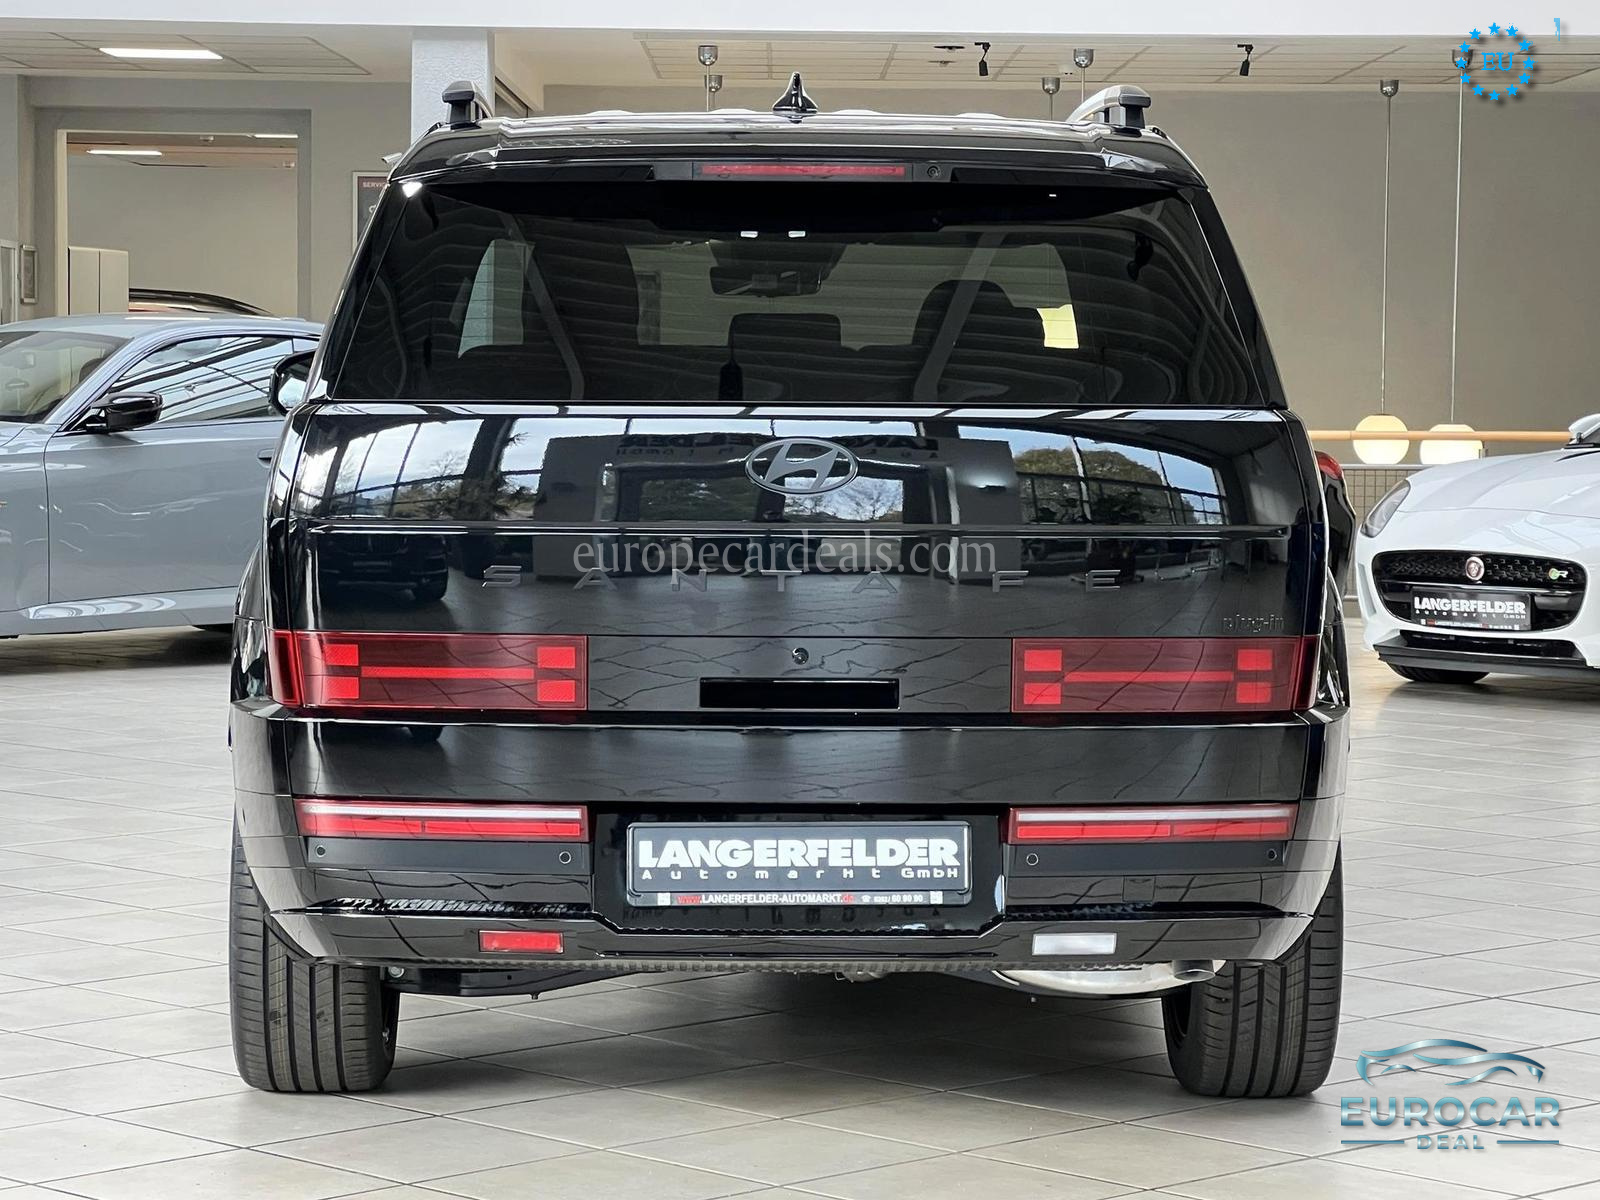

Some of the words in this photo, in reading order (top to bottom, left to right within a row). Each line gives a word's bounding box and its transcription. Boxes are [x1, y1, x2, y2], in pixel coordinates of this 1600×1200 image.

[482, 564, 899, 593] SANTA
[991, 569, 1122, 593] FE
[1414, 596, 1527, 615] LANGERFELDER
[1223, 614, 1285, 633] plug-in
[638, 838, 961, 868] LANGERFELDER
[901, 866, 959, 879] GmbH
